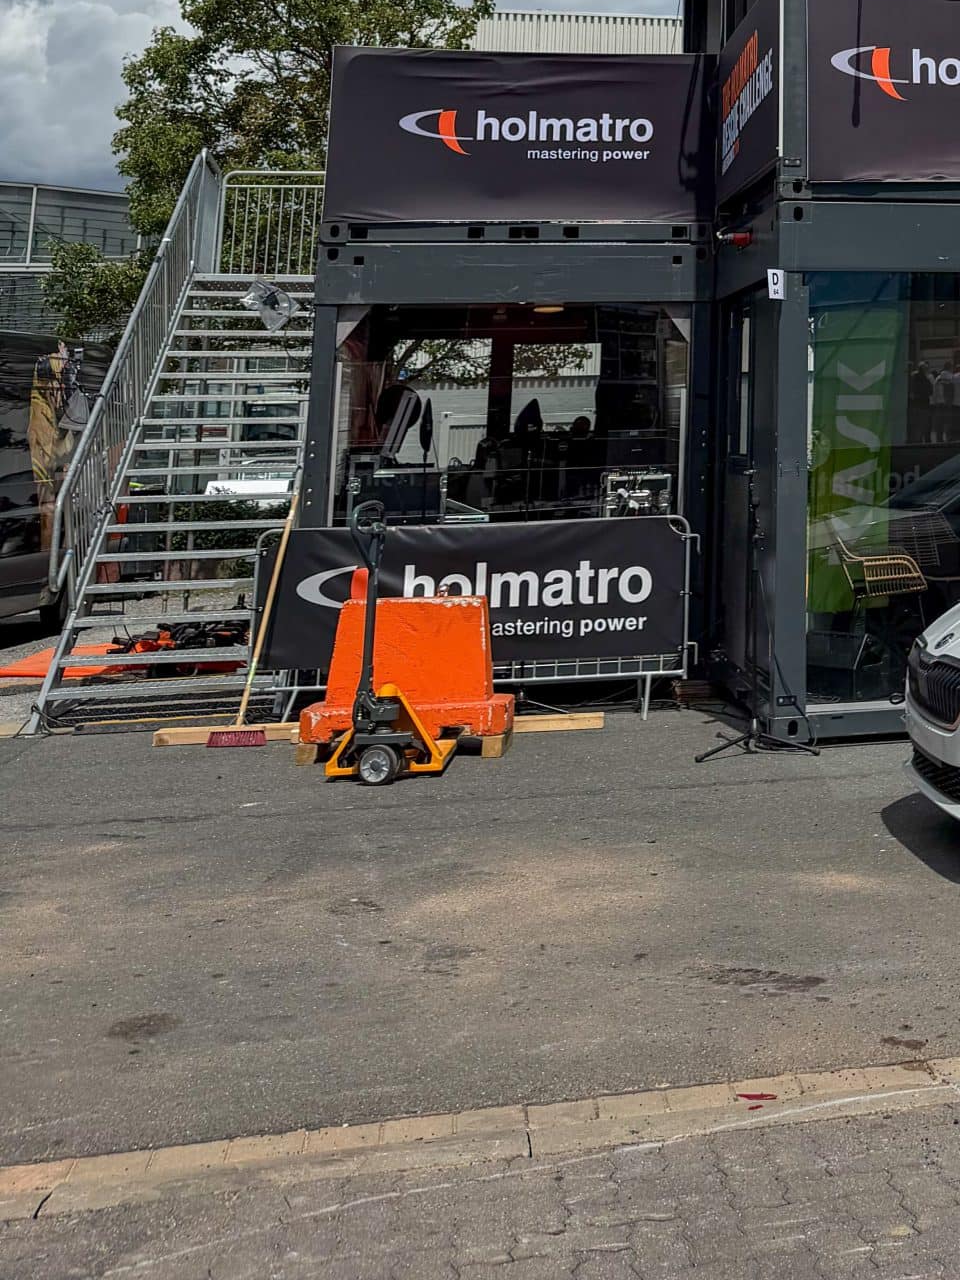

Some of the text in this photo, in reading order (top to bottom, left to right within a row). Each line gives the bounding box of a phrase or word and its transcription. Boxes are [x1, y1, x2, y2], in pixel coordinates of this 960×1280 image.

[739, 48, 773, 131] CHALLENGE
[476, 110, 654, 143] holmatro
[527, 148, 650, 161] mastering power
[772, 273, 779, 285] D
[492, 614, 647, 638] astering power
